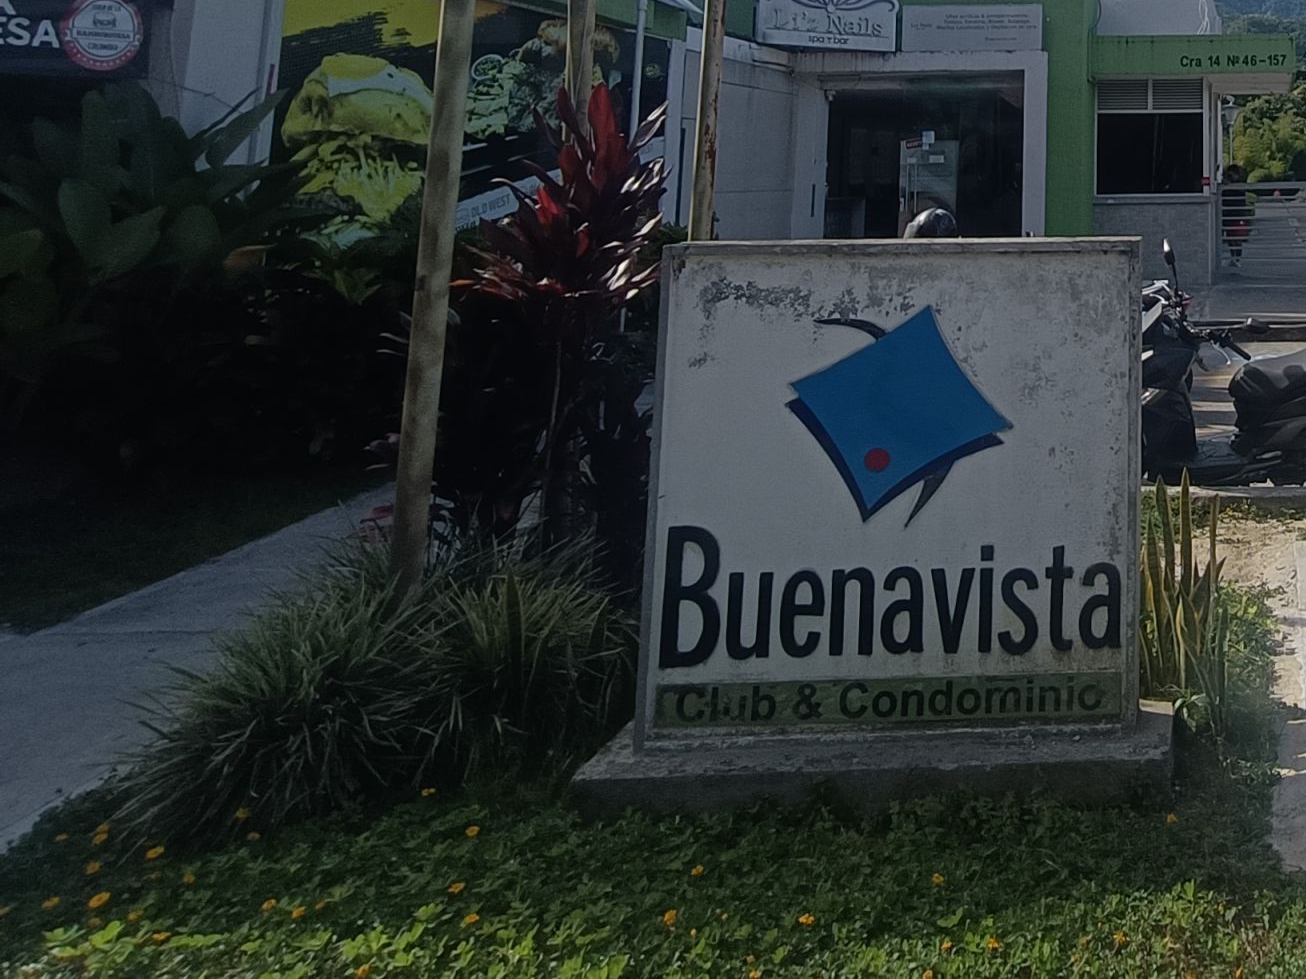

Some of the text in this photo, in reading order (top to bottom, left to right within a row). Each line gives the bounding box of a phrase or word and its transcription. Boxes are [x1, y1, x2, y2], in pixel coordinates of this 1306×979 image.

[827, 14, 883, 38] Nails
[834, 35, 849, 45] bar
[1180, 55, 1202, 67] Cra
[1208, 55, 1220, 67] 14
[659, 526, 1121, 669] Buenavista
[675, 681, 776, 722] Club
[792, 678, 823, 720] &
